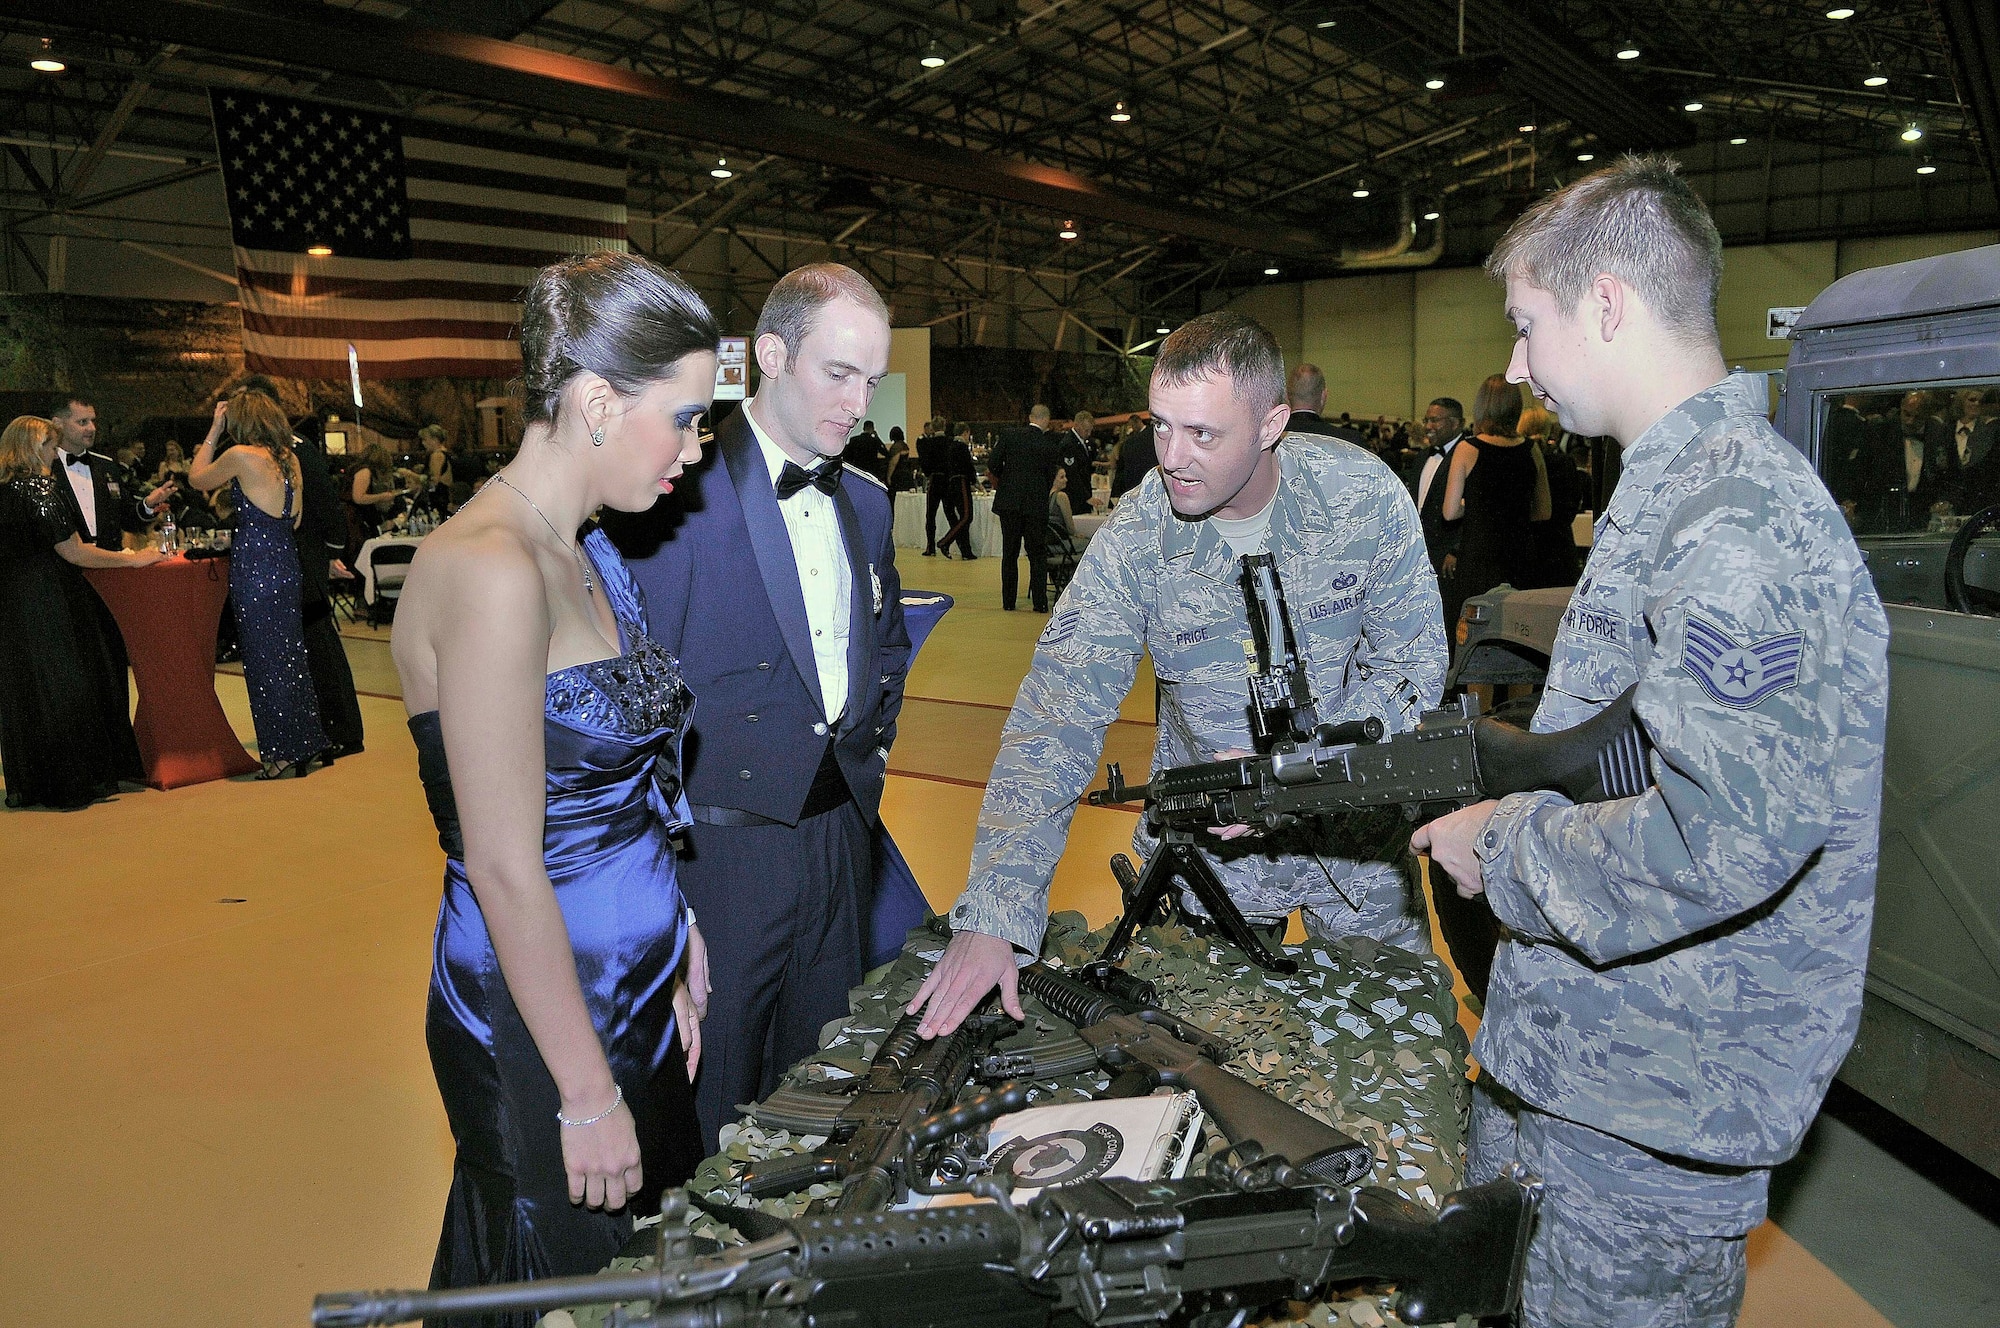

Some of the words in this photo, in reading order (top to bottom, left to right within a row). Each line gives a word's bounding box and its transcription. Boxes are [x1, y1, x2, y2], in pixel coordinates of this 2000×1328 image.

[1309, 604, 1331, 620] U.S.
[1332, 597, 1354, 615] AIR
[1563, 608, 1576, 629] IR
[1578, 612, 1618, 640] FORCE
[1176, 627, 1209, 646] PRICE
[1093, 1126, 1115, 1139] USAF
[1097, 1139, 1118, 1169] COMBAT
[1065, 1167, 1099, 1187] ARMS
